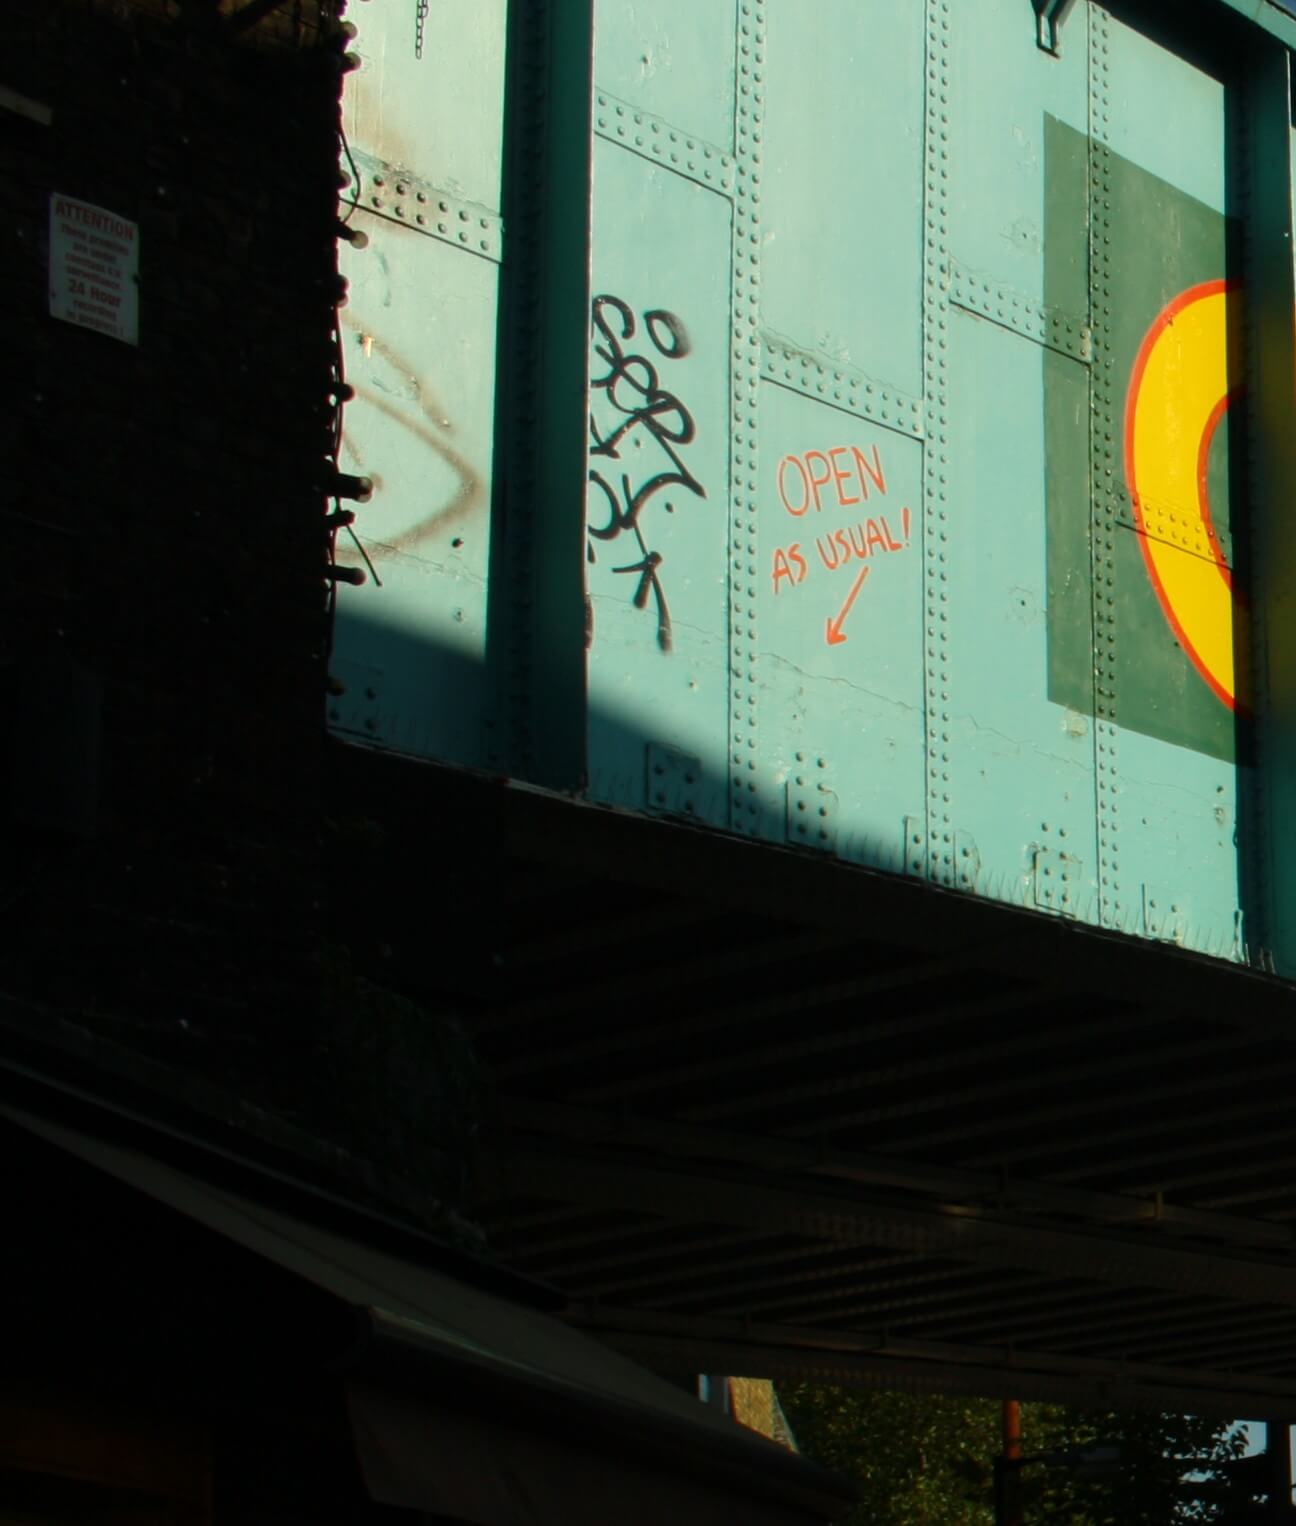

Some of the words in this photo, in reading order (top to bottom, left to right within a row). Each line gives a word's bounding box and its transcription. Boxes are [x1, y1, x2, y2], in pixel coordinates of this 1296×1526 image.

[57, 198, 133, 242] ATTENTION
[69, 279, 85, 296] 24
[90, 287, 121, 308] Hour
[778, 444, 886, 517] OPEN
[772, 543, 808, 595] AS
[816, 507, 911, 571] USUAL!
